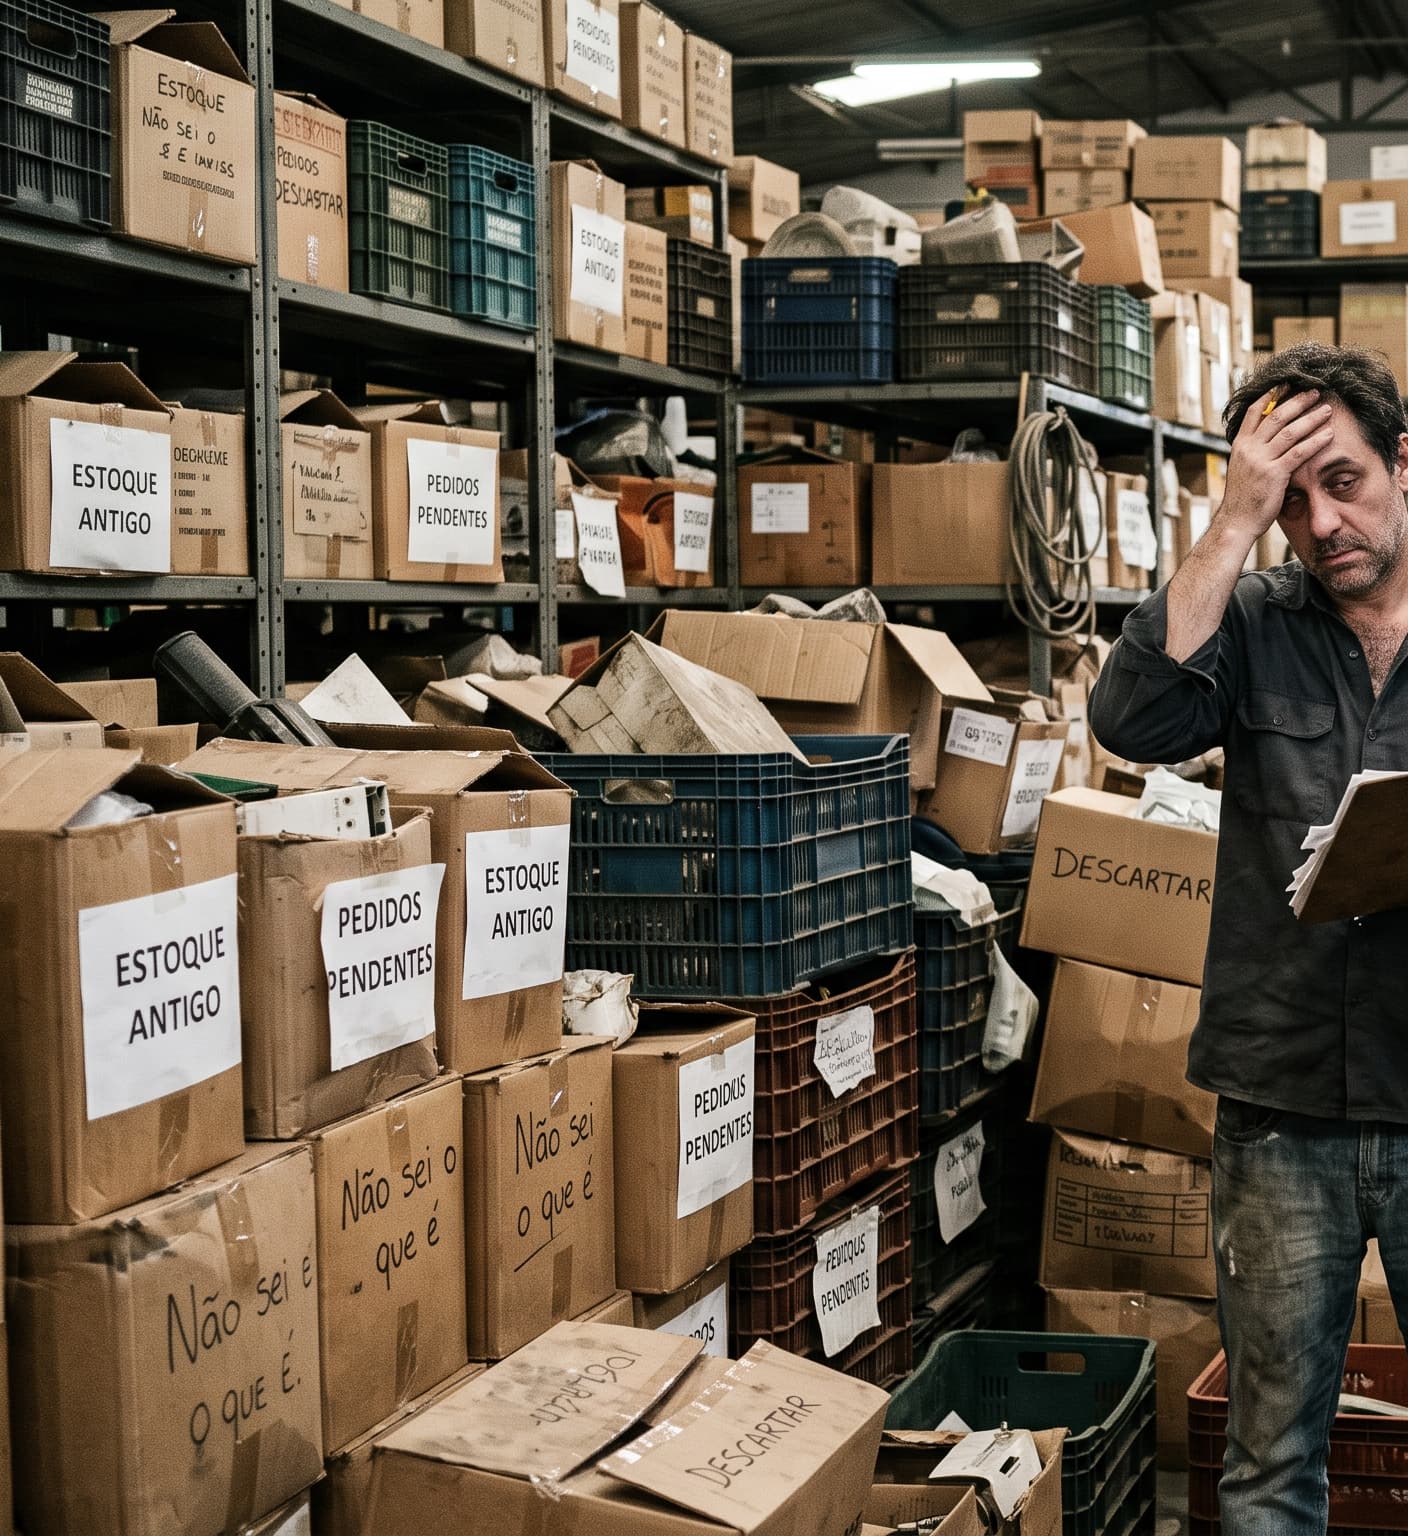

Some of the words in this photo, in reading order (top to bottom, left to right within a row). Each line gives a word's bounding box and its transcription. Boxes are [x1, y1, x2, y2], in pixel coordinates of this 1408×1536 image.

[142, 106, 169, 130] NÃO
[157, 73, 226, 113] ESTOQUE
[581, 229, 620, 259] ESTOQUE
[584, 257, 617, 283] ANTIGO
[72, 463, 158, 497] ESTOQUE
[427, 474, 480, 496] PEDIDOS
[78, 507, 151, 535] ANTIGO
[417, 505, 488, 529] PENDENTES
[485, 861, 560, 894] ESTOQUE
[1051, 847, 1211, 904] DESCARTAR
[338, 891, 422, 938] PEDIDOS
[491, 905, 553, 940] ANTIGO
[116, 926, 225, 988] ESTOQUE
[328, 943, 433, 999] PENDENTES
[128, 985, 221, 1044] ANTIGO
[516, 1111, 560, 1175] Não
[570, 1102, 594, 1147] sei
[686, 1111, 752, 1165] PENDENTES
[342, 1168, 390, 1230] Não
[402, 1145, 432, 1198] sei
[542, 1180, 574, 1240] que
[583, 1153, 594, 1200] é
[376, 1230, 417, 1291] que
[427, 1199, 440, 1247] é
[168, 1284, 240, 1374] Não
[256, 1258, 289, 1316] sei
[685, 1395, 822, 1489] DESCARTAR
